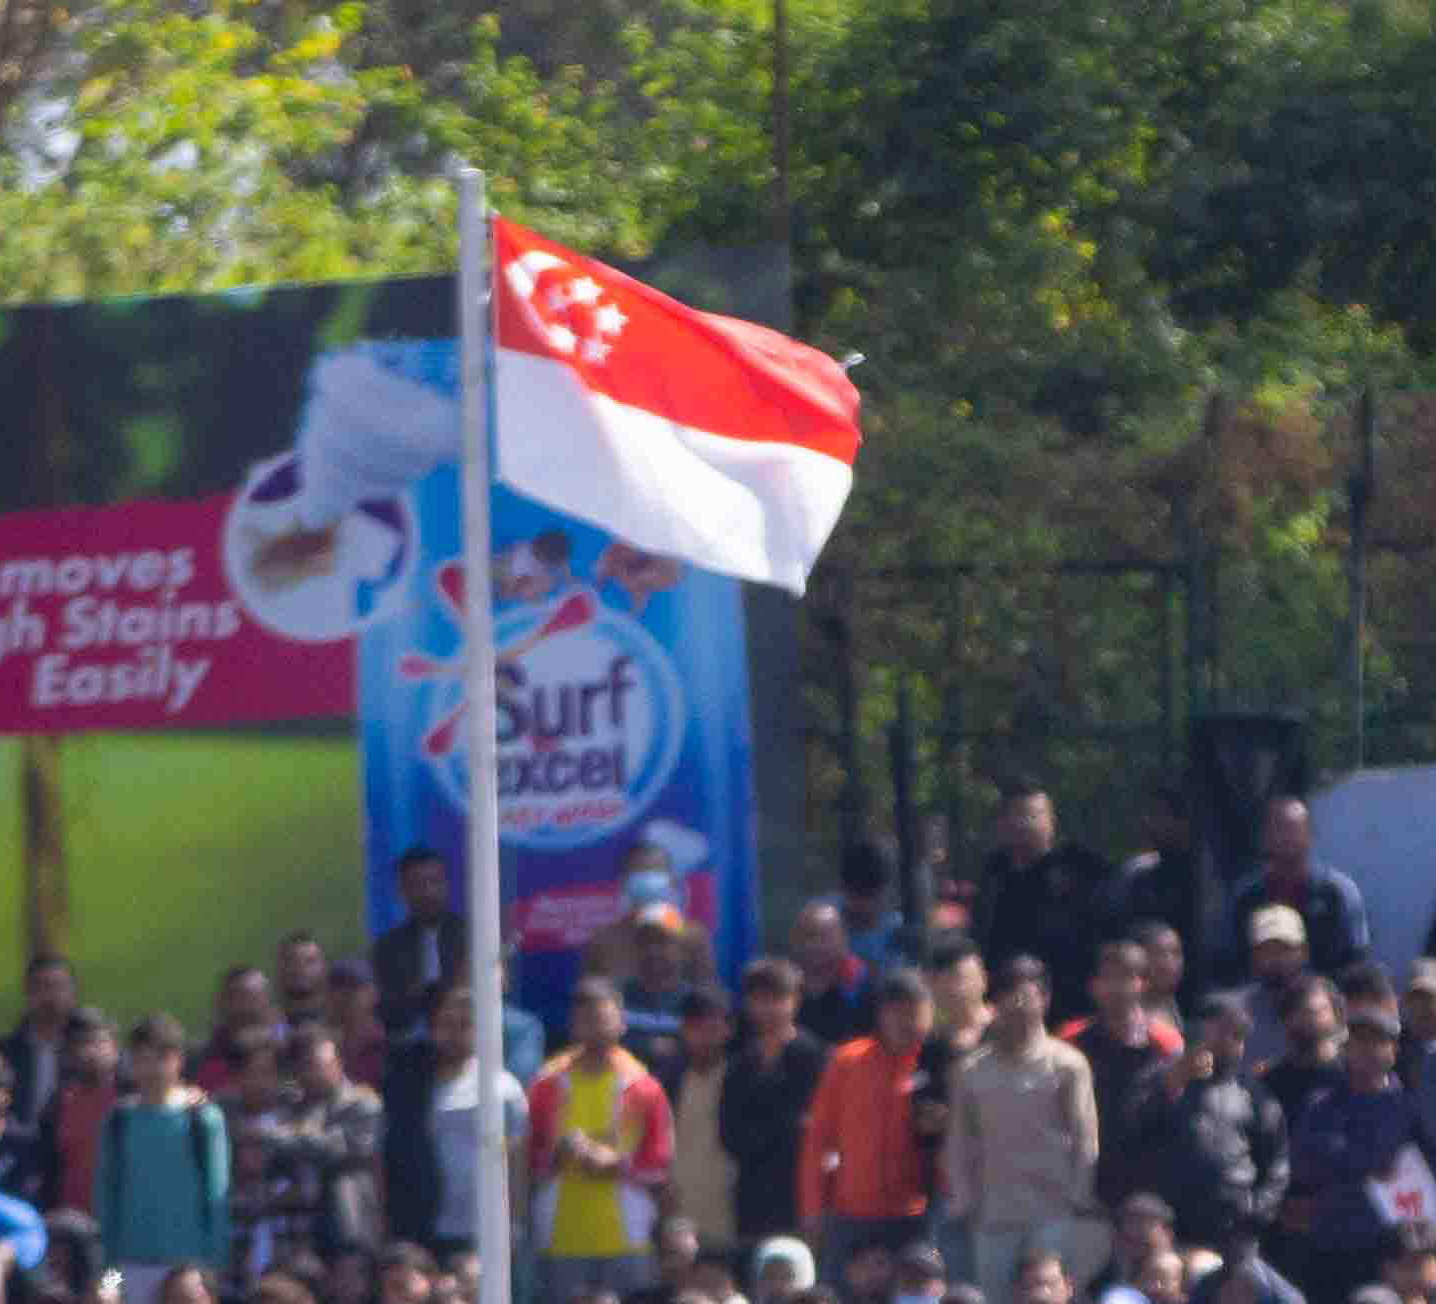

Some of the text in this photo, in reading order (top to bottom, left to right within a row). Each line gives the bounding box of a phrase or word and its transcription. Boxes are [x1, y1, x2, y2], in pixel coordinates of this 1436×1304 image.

[59, 594, 242, 648] Stains
[29, 645, 211, 712] Easily
[496, 656, 637, 743] Surf
